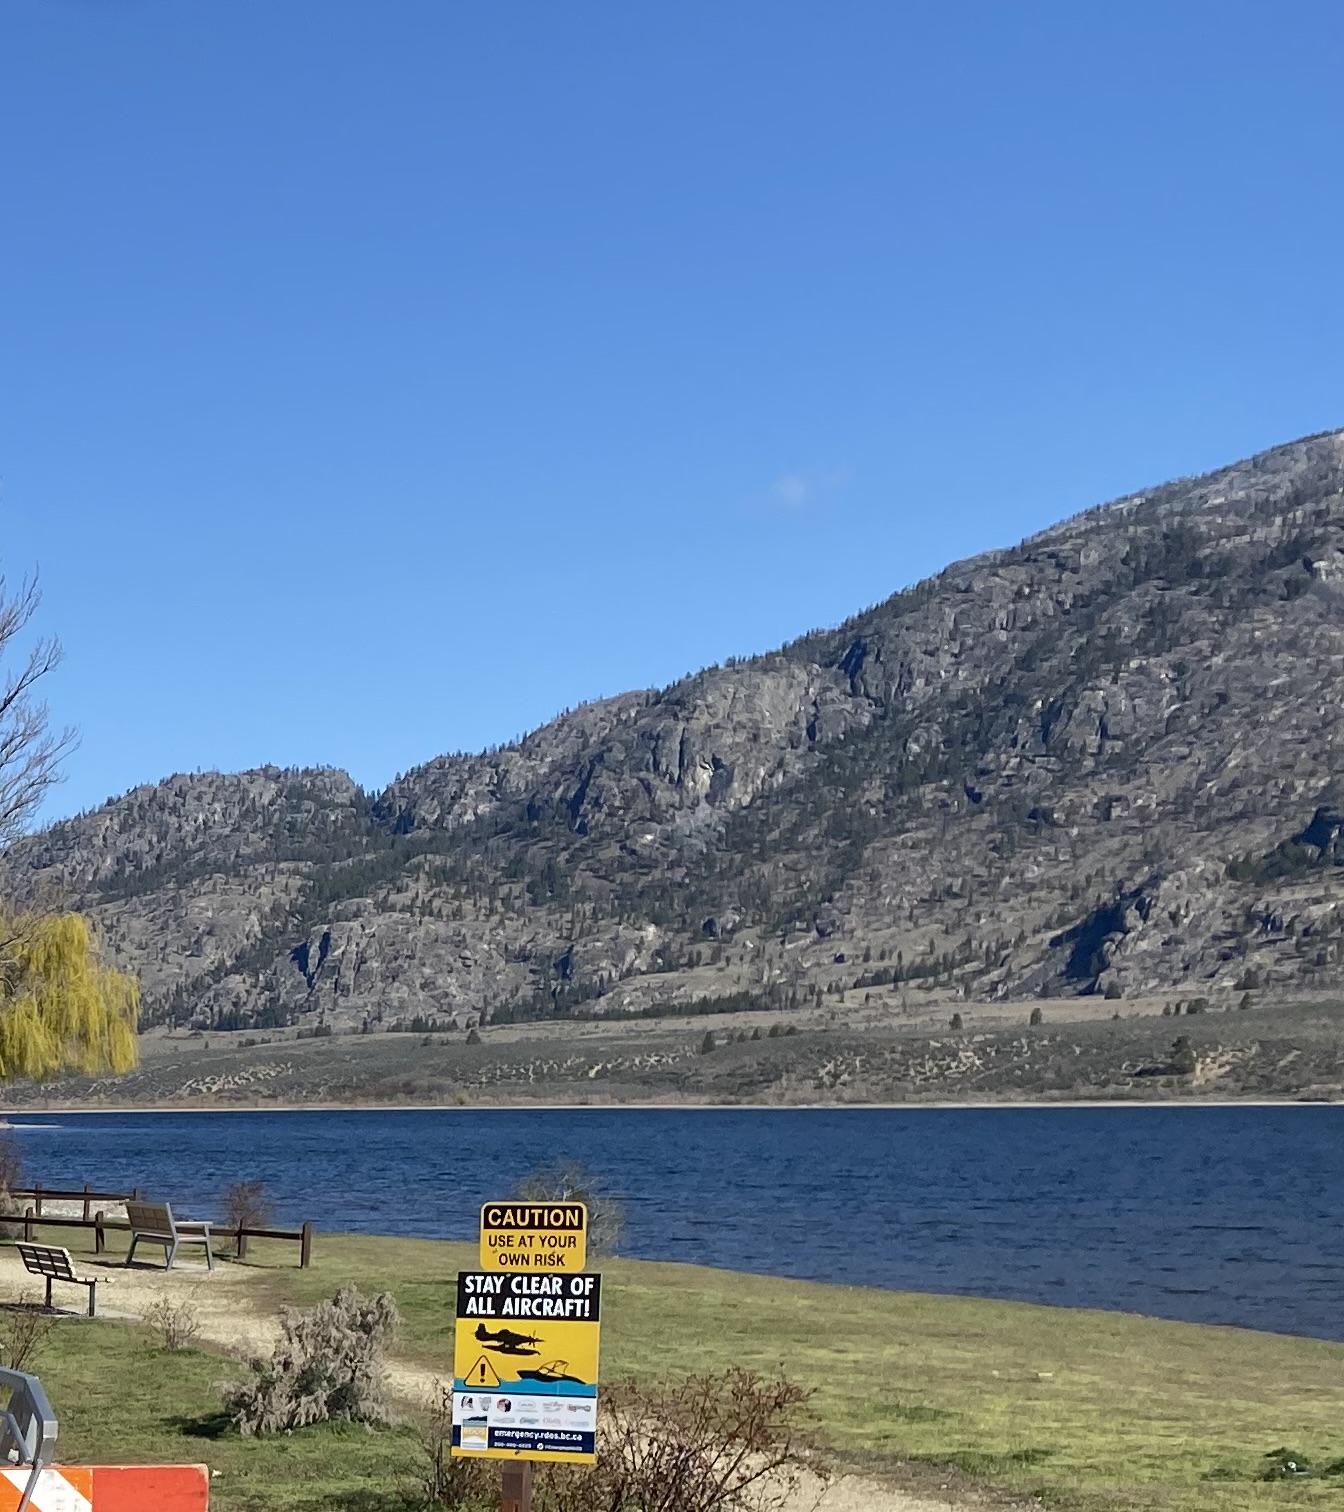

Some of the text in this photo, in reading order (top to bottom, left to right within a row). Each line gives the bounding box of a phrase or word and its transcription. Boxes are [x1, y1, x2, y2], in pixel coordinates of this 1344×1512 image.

[488, 1208, 579, 1227] CAUTION
[488, 1234, 577, 1248] USE AT YOUR
[498, 1253, 566, 1267] OWN RISK
[465, 1276, 595, 1296] STAY CLEAR OF
[465, 1296, 591, 1318] ALL AIRCRAFT!
